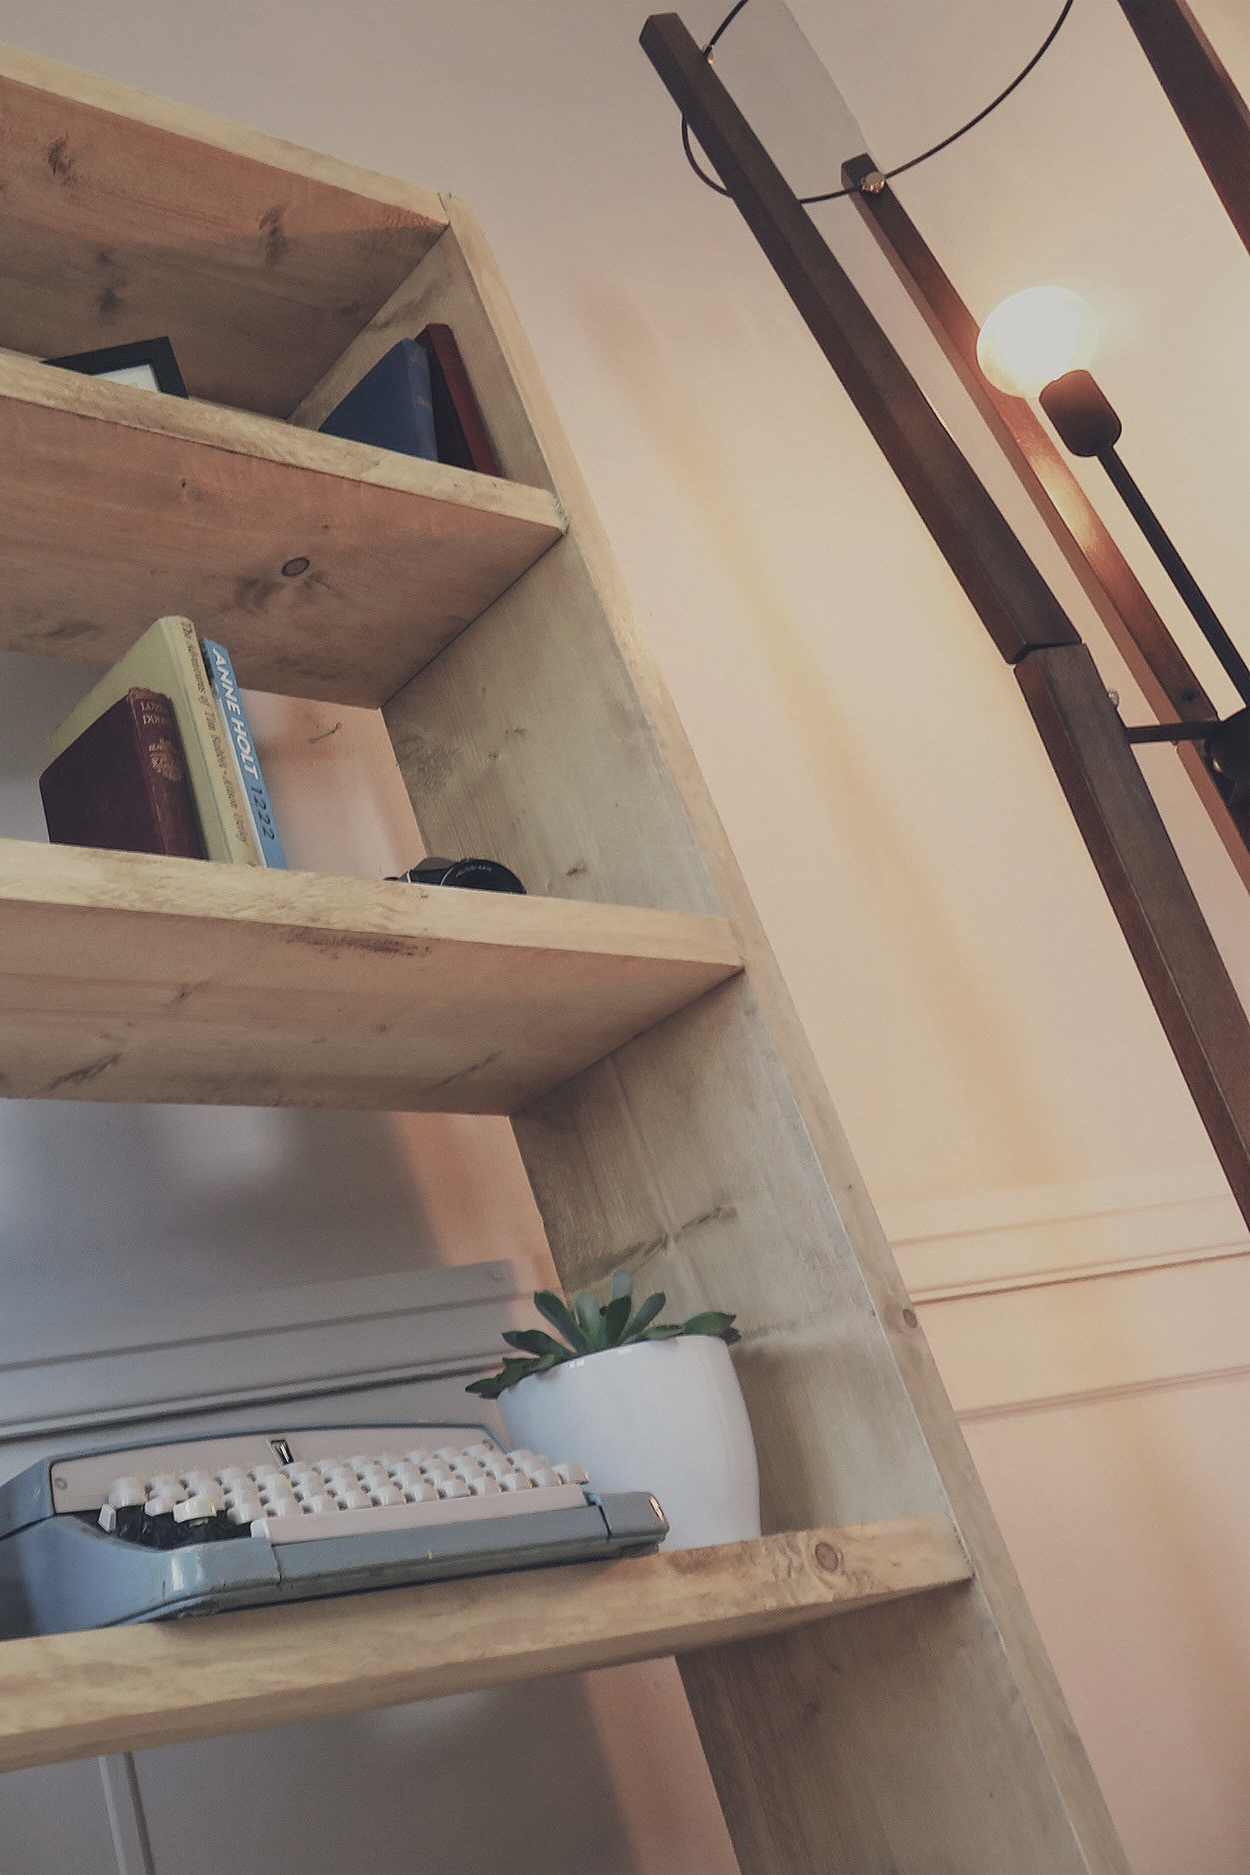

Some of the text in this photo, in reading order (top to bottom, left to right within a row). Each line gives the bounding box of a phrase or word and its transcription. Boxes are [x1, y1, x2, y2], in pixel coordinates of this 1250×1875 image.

[212, 647, 259, 780] ANNE HOLT
[251, 785, 275, 841] 1222
